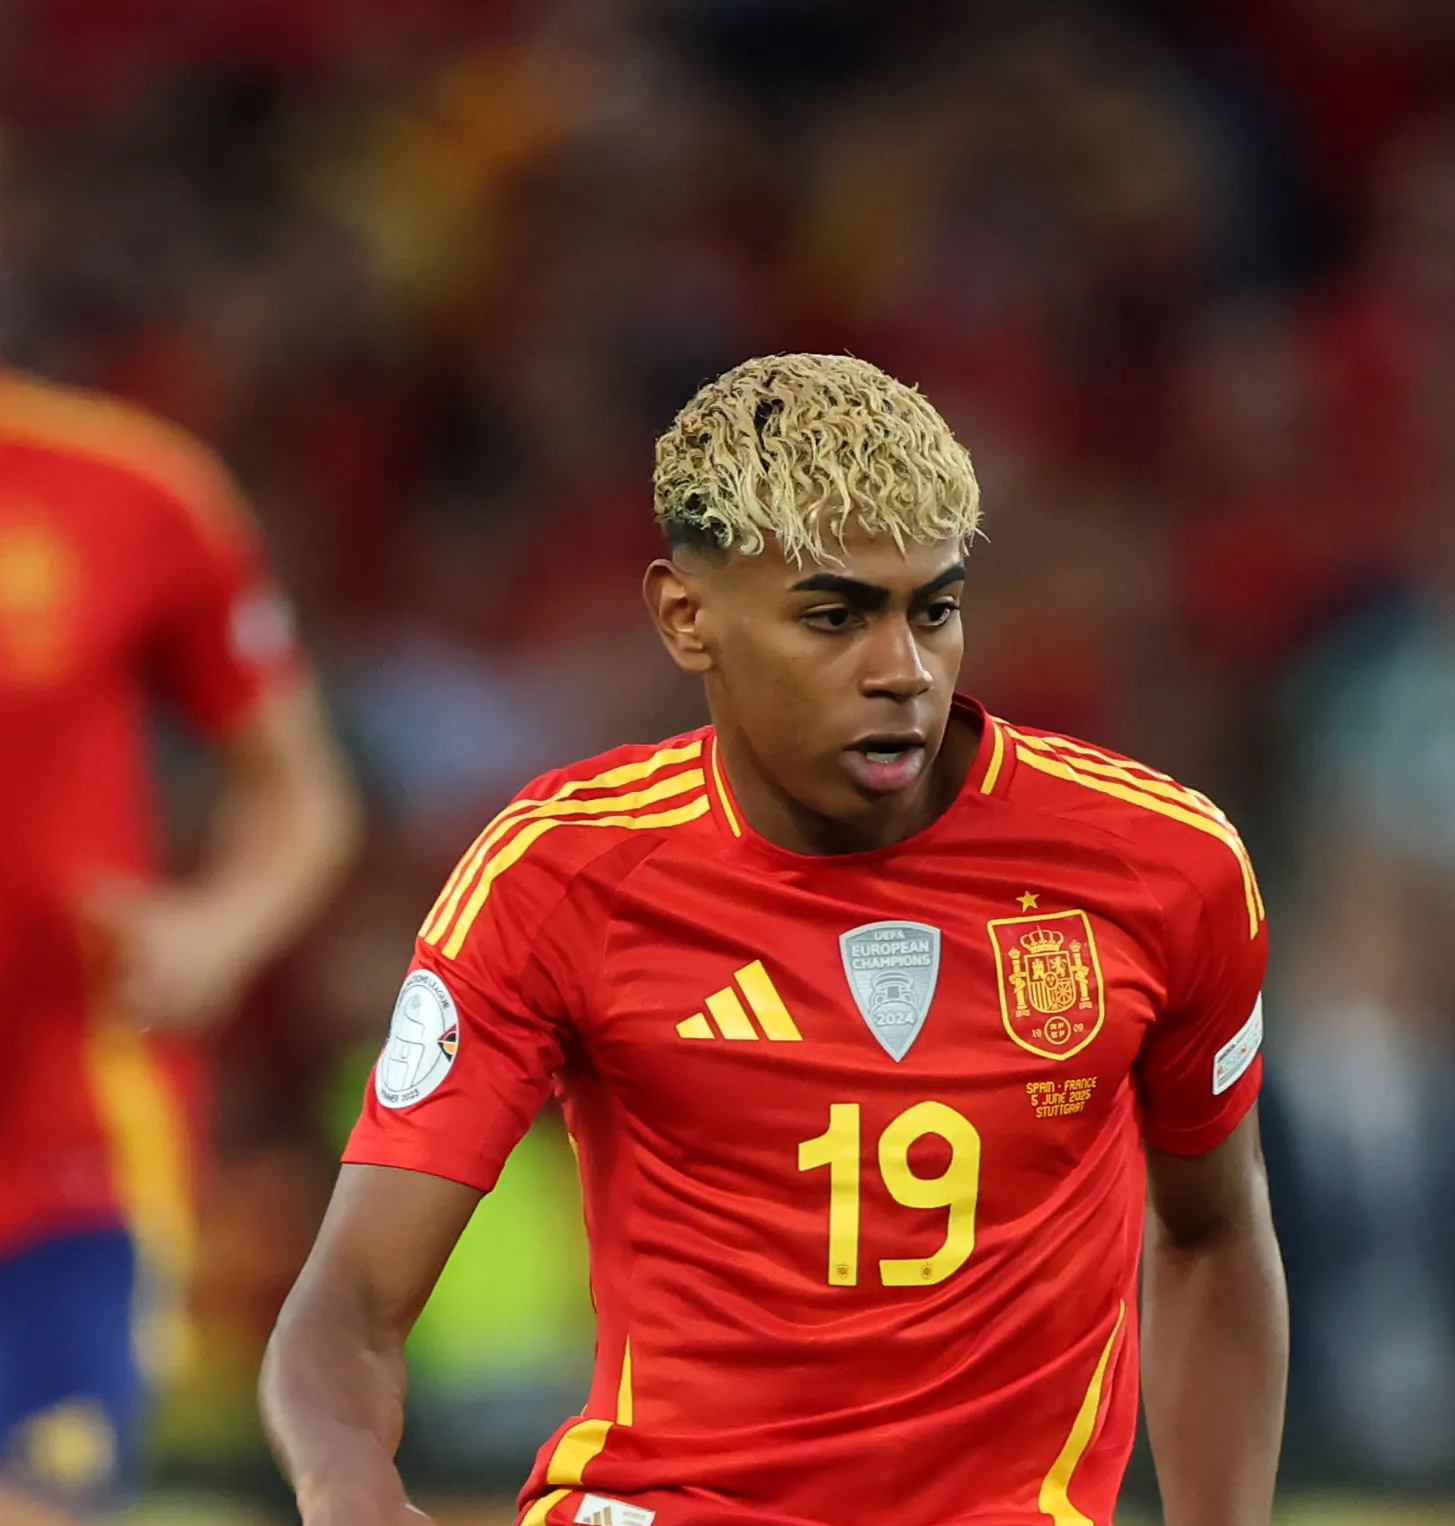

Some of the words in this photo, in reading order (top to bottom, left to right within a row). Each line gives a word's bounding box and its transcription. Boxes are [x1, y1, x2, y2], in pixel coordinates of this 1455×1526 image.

[874, 929, 905, 941] UEFA
[852, 940, 930, 957] EUROPEAN
[852, 953, 932, 970] CHAMPIONS
[877, 1012, 915, 1026] 2024
[1026, 1082, 1055, 1095] SPAIN
[1064, 1076, 1097, 1092] FRANCE
[1031, 1094, 1039, 1107] 5
[1042, 1092, 1066, 1106] JUNE
[1069, 1089, 1091, 1103] 2025
[1036, 1101, 1085, 1119] STUTTGART
[797, 1100, 982, 1287] 19
